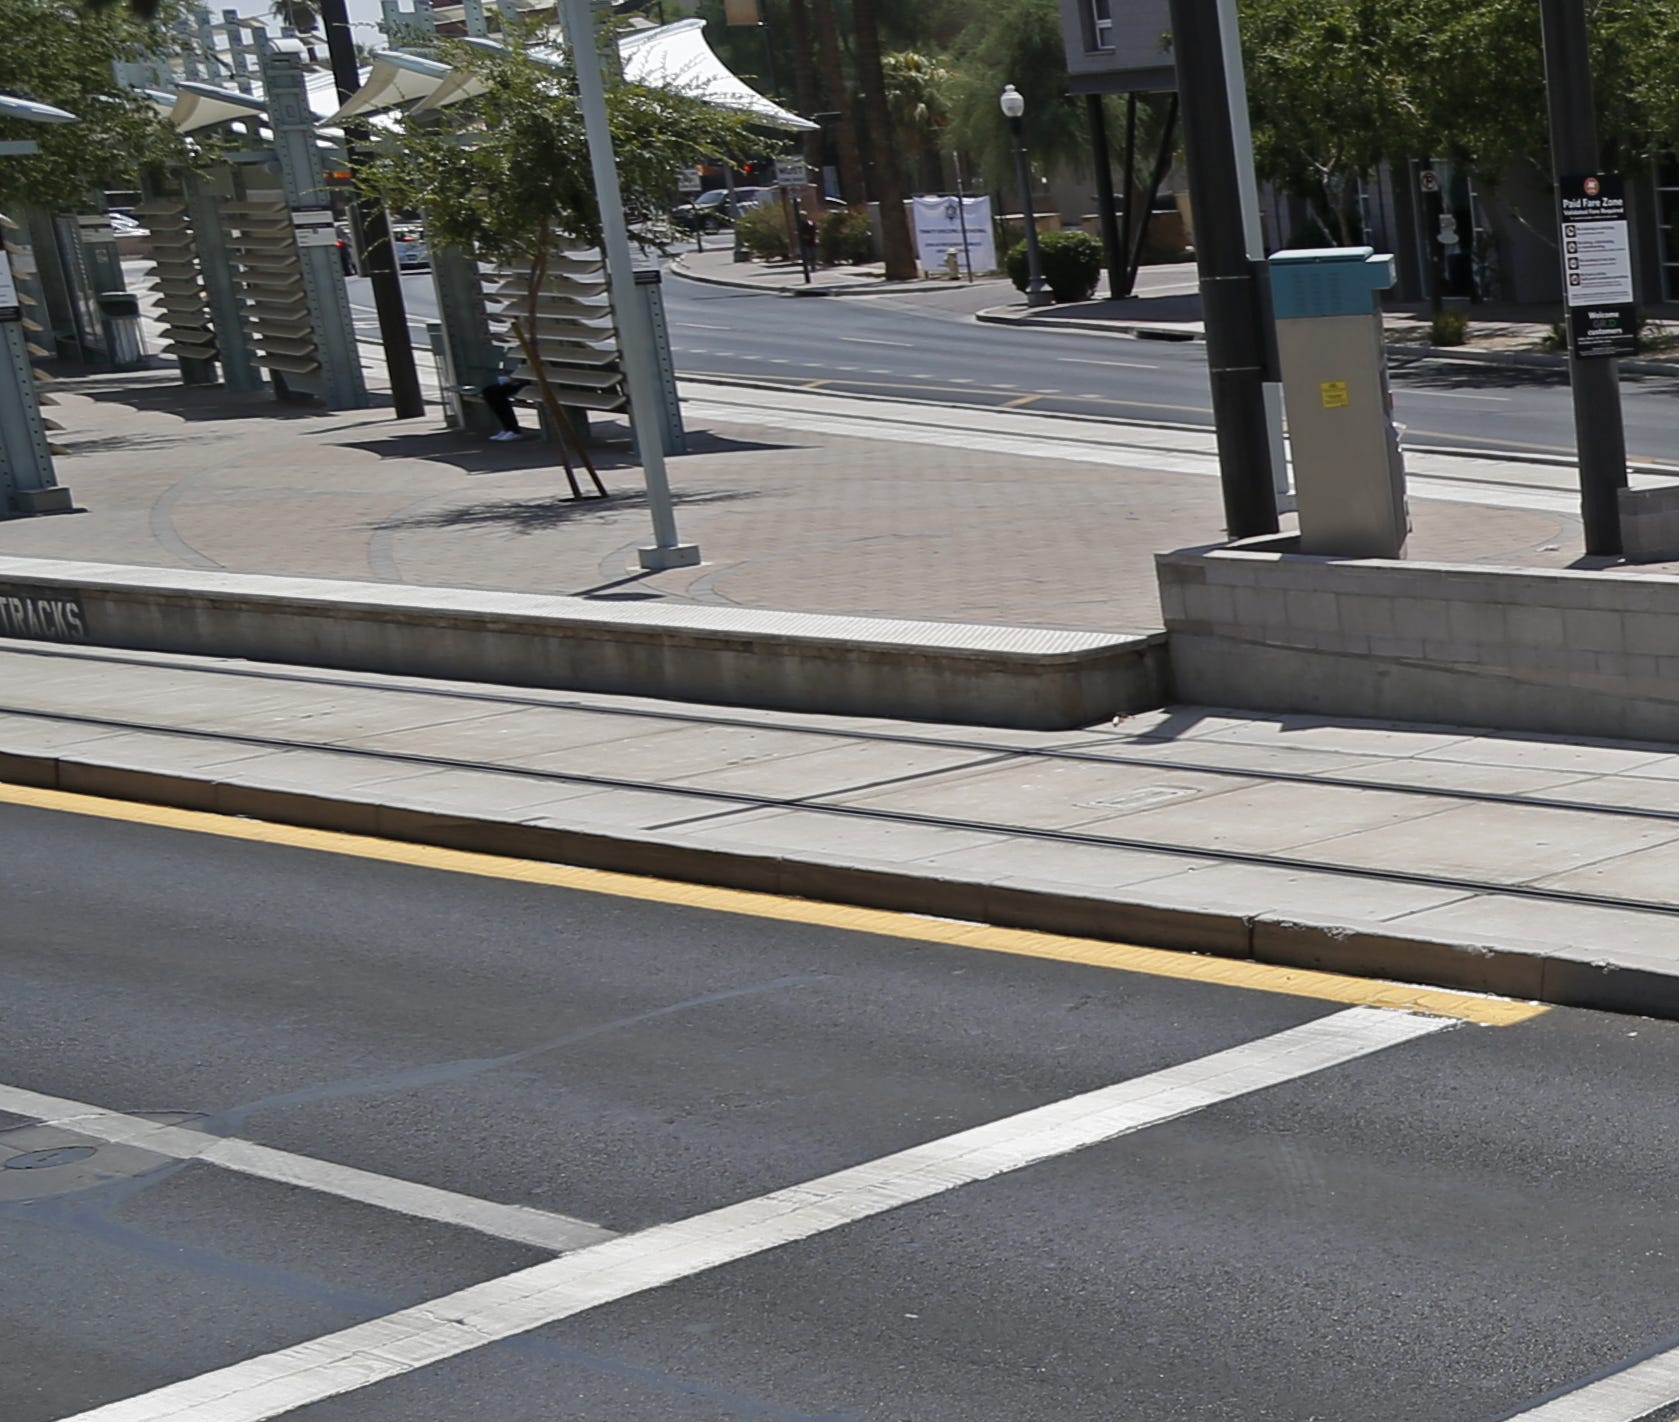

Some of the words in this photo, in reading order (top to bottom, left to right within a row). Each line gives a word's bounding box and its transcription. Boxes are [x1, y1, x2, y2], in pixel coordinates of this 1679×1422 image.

[1562, 198, 1581, 208] Paid
[1582, 198, 1600, 207] Fare
[1602, 197, 1623, 207] Zone
[1587, 311, 1620, 319] Welcome
[0, 595, 84, 639] TRACKS
